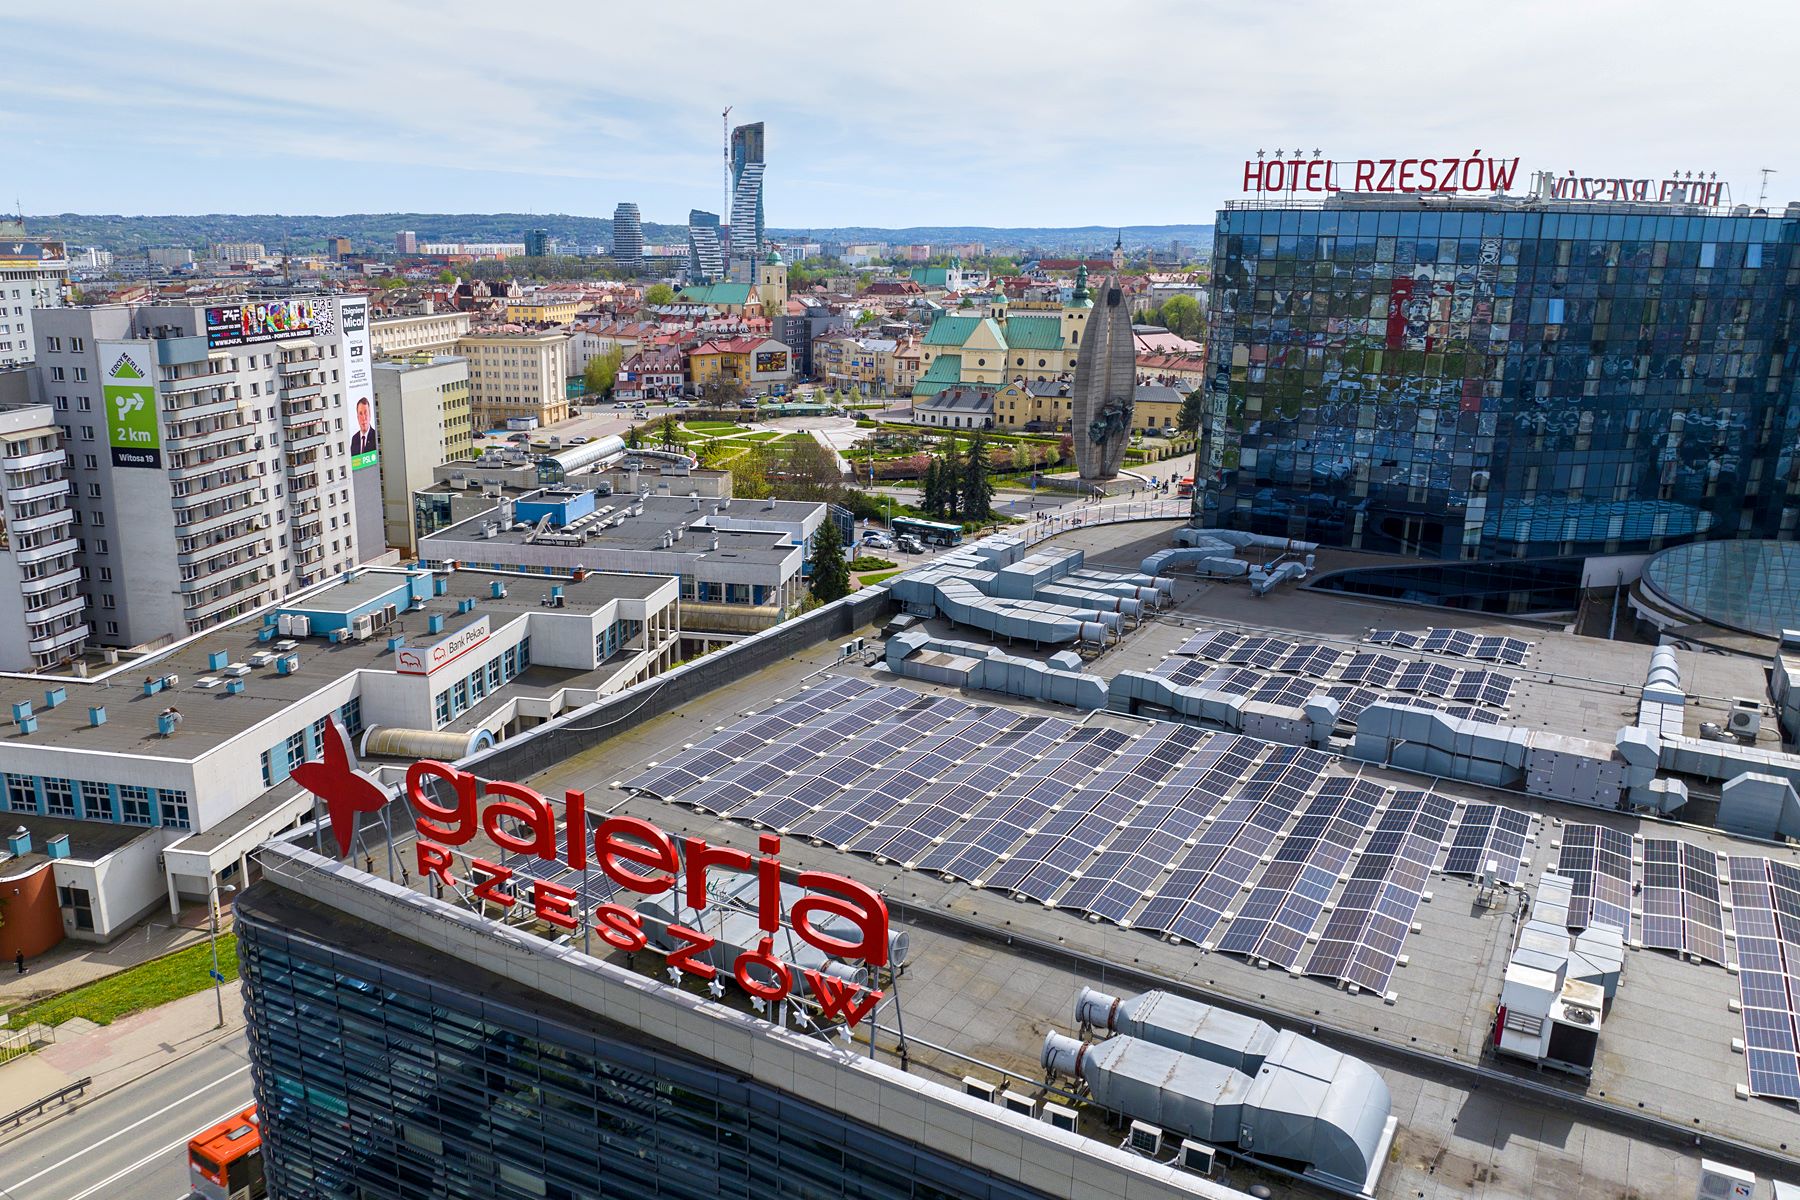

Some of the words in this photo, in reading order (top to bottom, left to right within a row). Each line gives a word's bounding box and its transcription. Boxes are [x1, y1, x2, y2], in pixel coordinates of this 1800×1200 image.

[1243, 160, 1341, 192] HOTEL
[1354, 149, 1520, 192] RZESZÓW
[343, 307, 365, 316] Zbigniew
[343, 316, 364, 328] Micał
[246, 335, 272, 343] FOTOBUDKA
[108, 357, 124, 377] LEROY
[121, 352, 146, 378] MERLIN
[117, 428, 126, 441] 2
[128, 427, 151, 442] km
[118, 453, 145, 463] Witosa
[145, 455, 154, 463] 19
[448, 637, 465, 654] Bank
[465, 626, 485, 644] Pekao
[406, 759, 889, 967] galeria
[416, 840, 884, 1027] RZESZÓW
